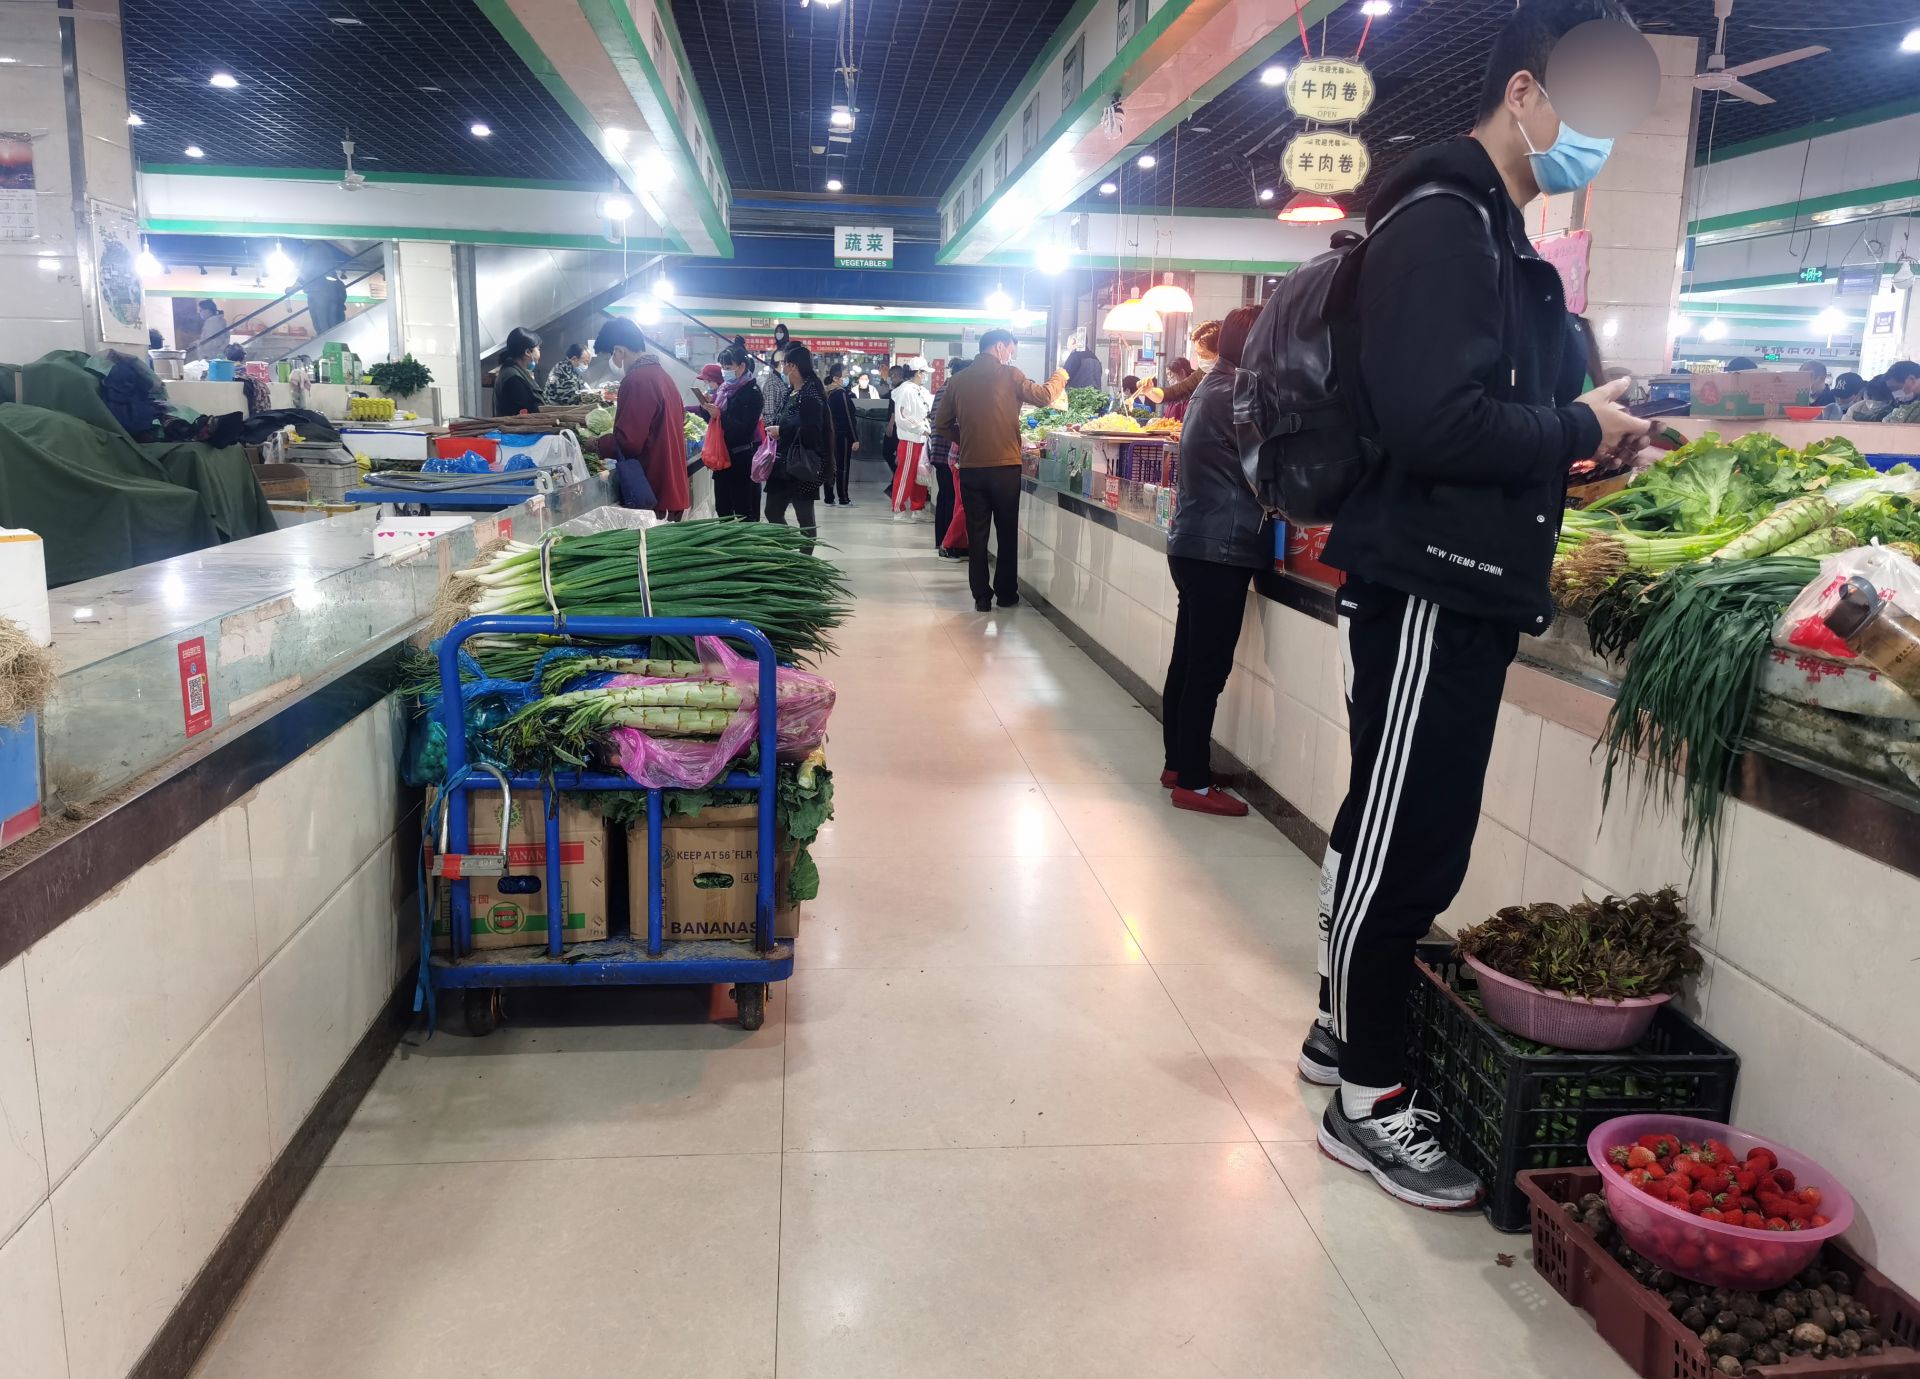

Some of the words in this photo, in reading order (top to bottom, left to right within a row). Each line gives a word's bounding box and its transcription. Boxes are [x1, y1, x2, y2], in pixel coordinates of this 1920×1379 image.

[1301, 79, 1357, 101] 牛肉卷
[1317, 110, 1337, 118] OPEN
[1298, 152, 1353, 173] 羊肉卷
[1314, 182, 1334, 190] OPEN
[844, 233, 883, 251] 蔬菜
[840, 259, 887, 267] VEGETABLES
[1426, 544, 1447, 558] NEW
[1448, 553, 1475, 568] ITEMS
[1478, 562, 1503, 576] COMIN
[676, 851, 702, 860] KEEP
[704, 851, 716, 859] AT
